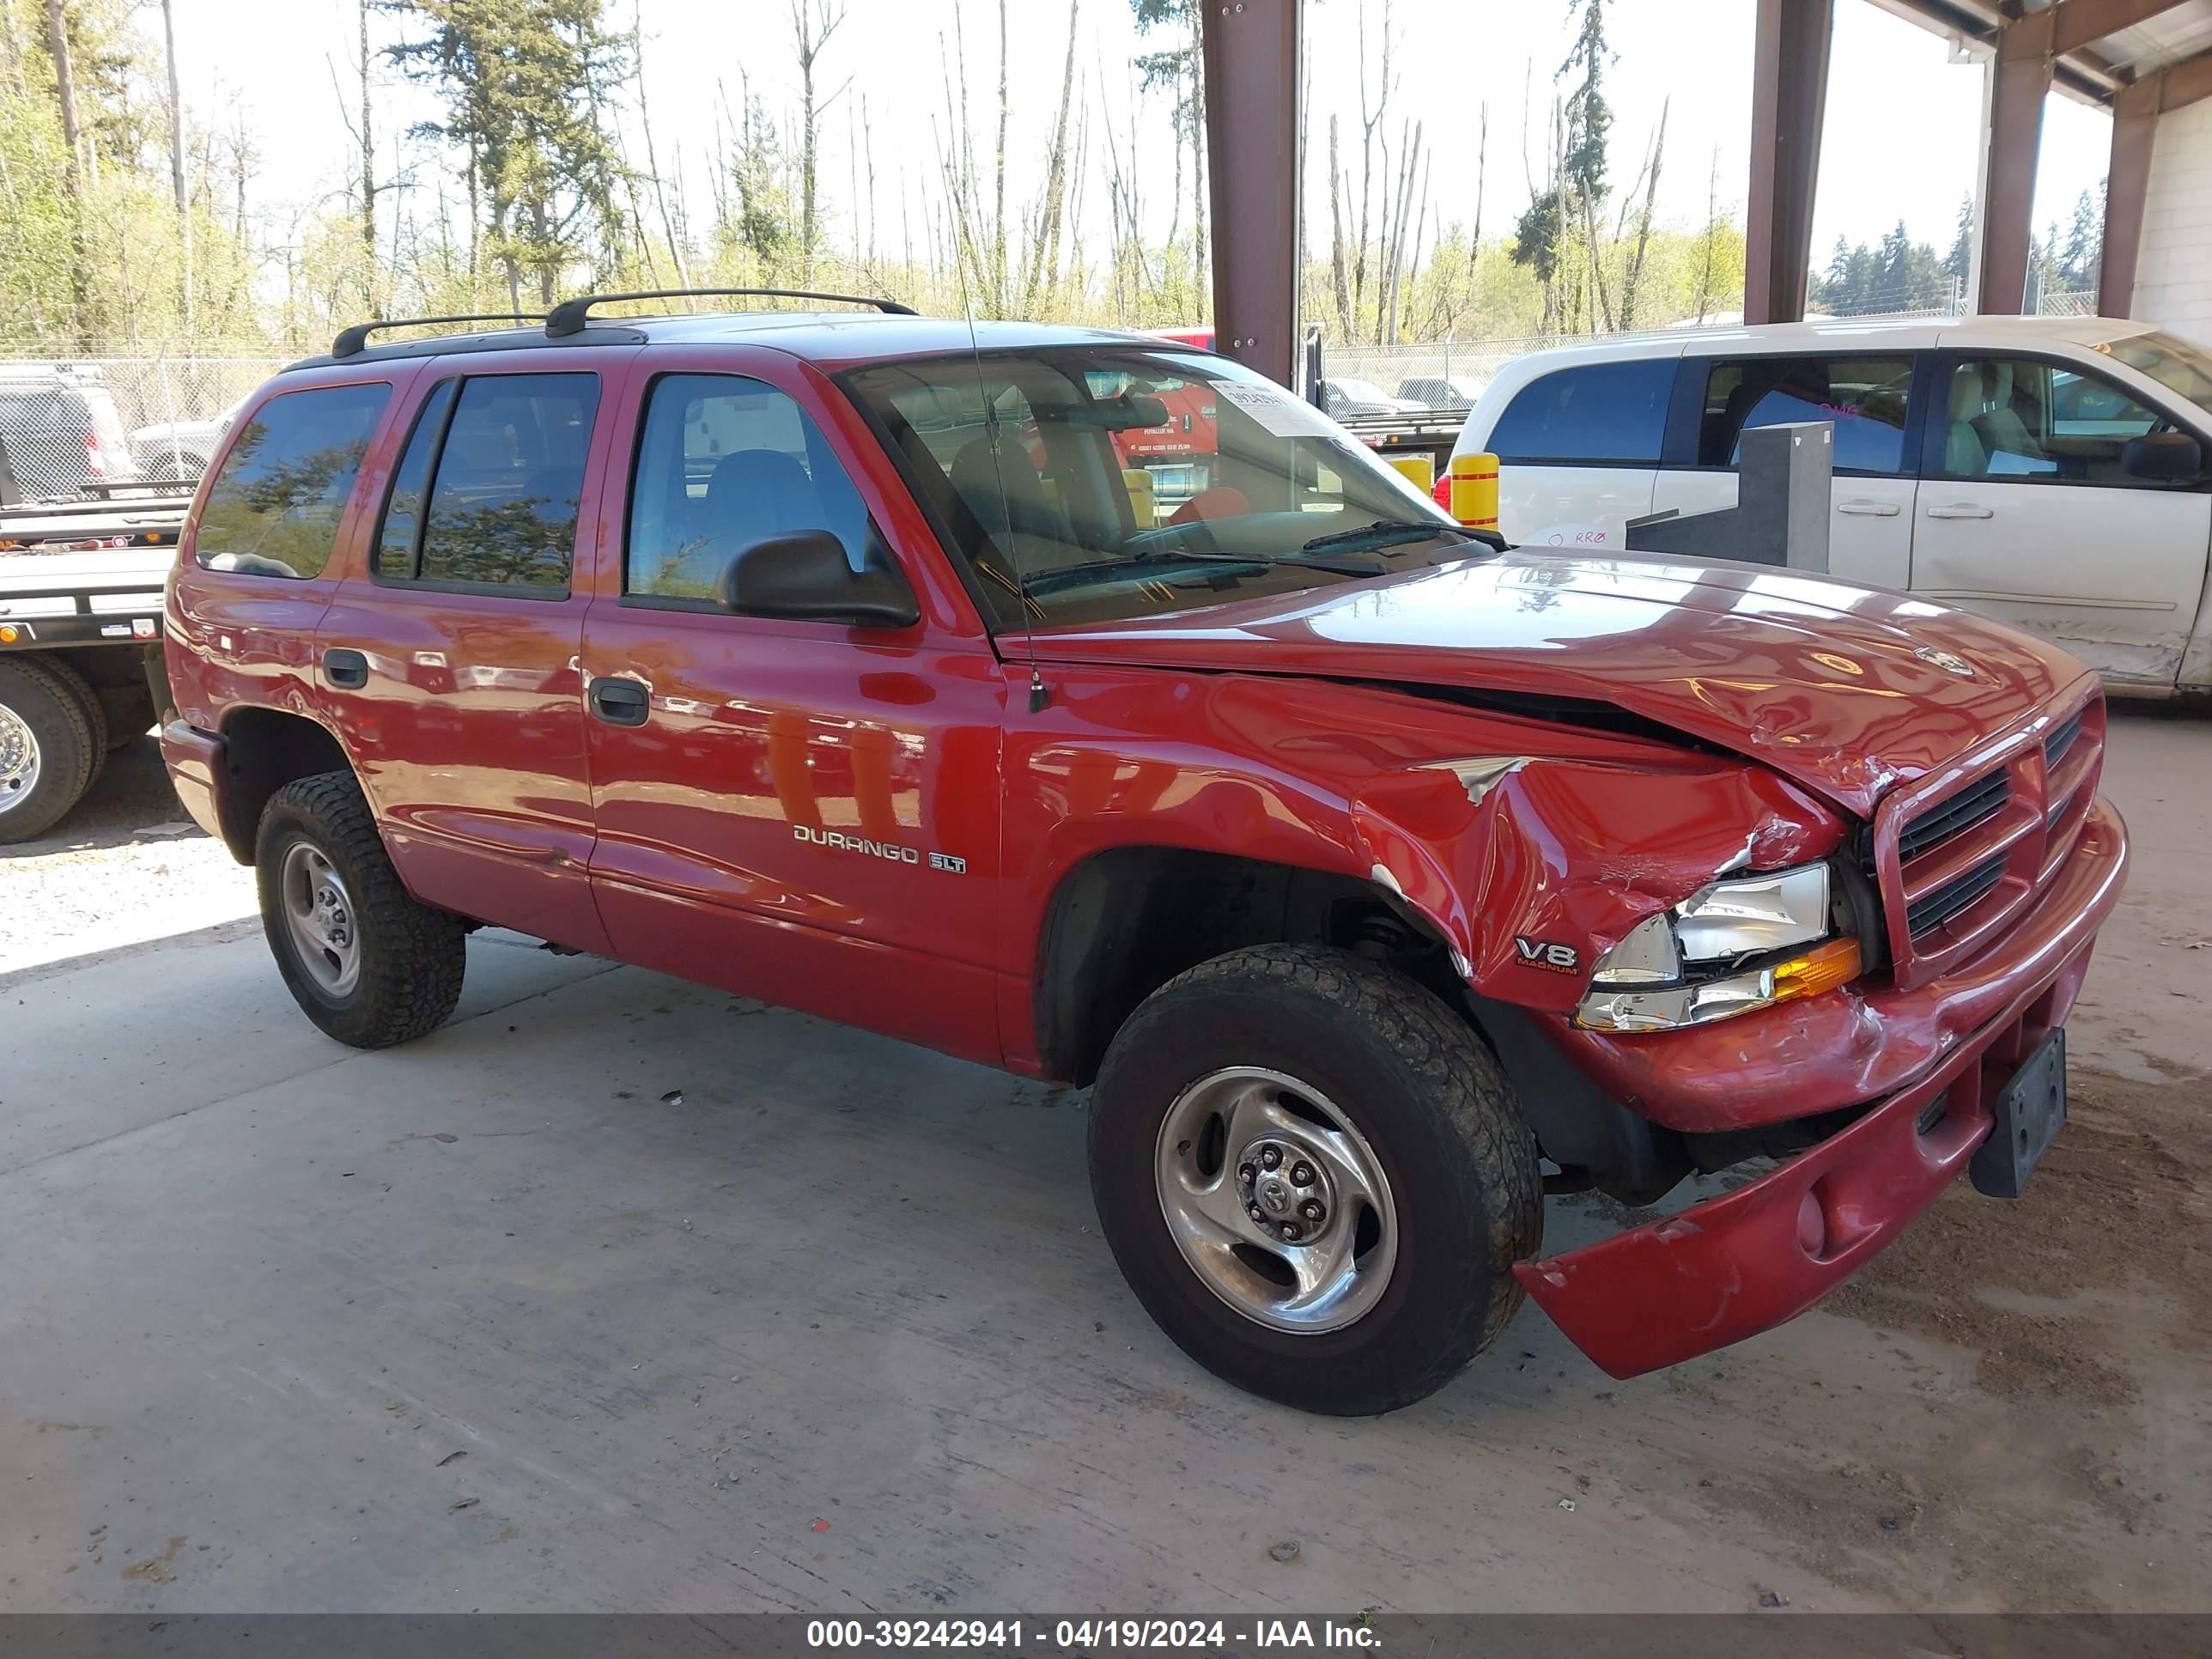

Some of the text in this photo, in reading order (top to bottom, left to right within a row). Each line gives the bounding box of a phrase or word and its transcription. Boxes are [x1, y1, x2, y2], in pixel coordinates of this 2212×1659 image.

[793, 824, 966, 873] DURANGO SLT
[1515, 938, 1577, 967] V8
[1516, 957, 1578, 975] MAGNUM
